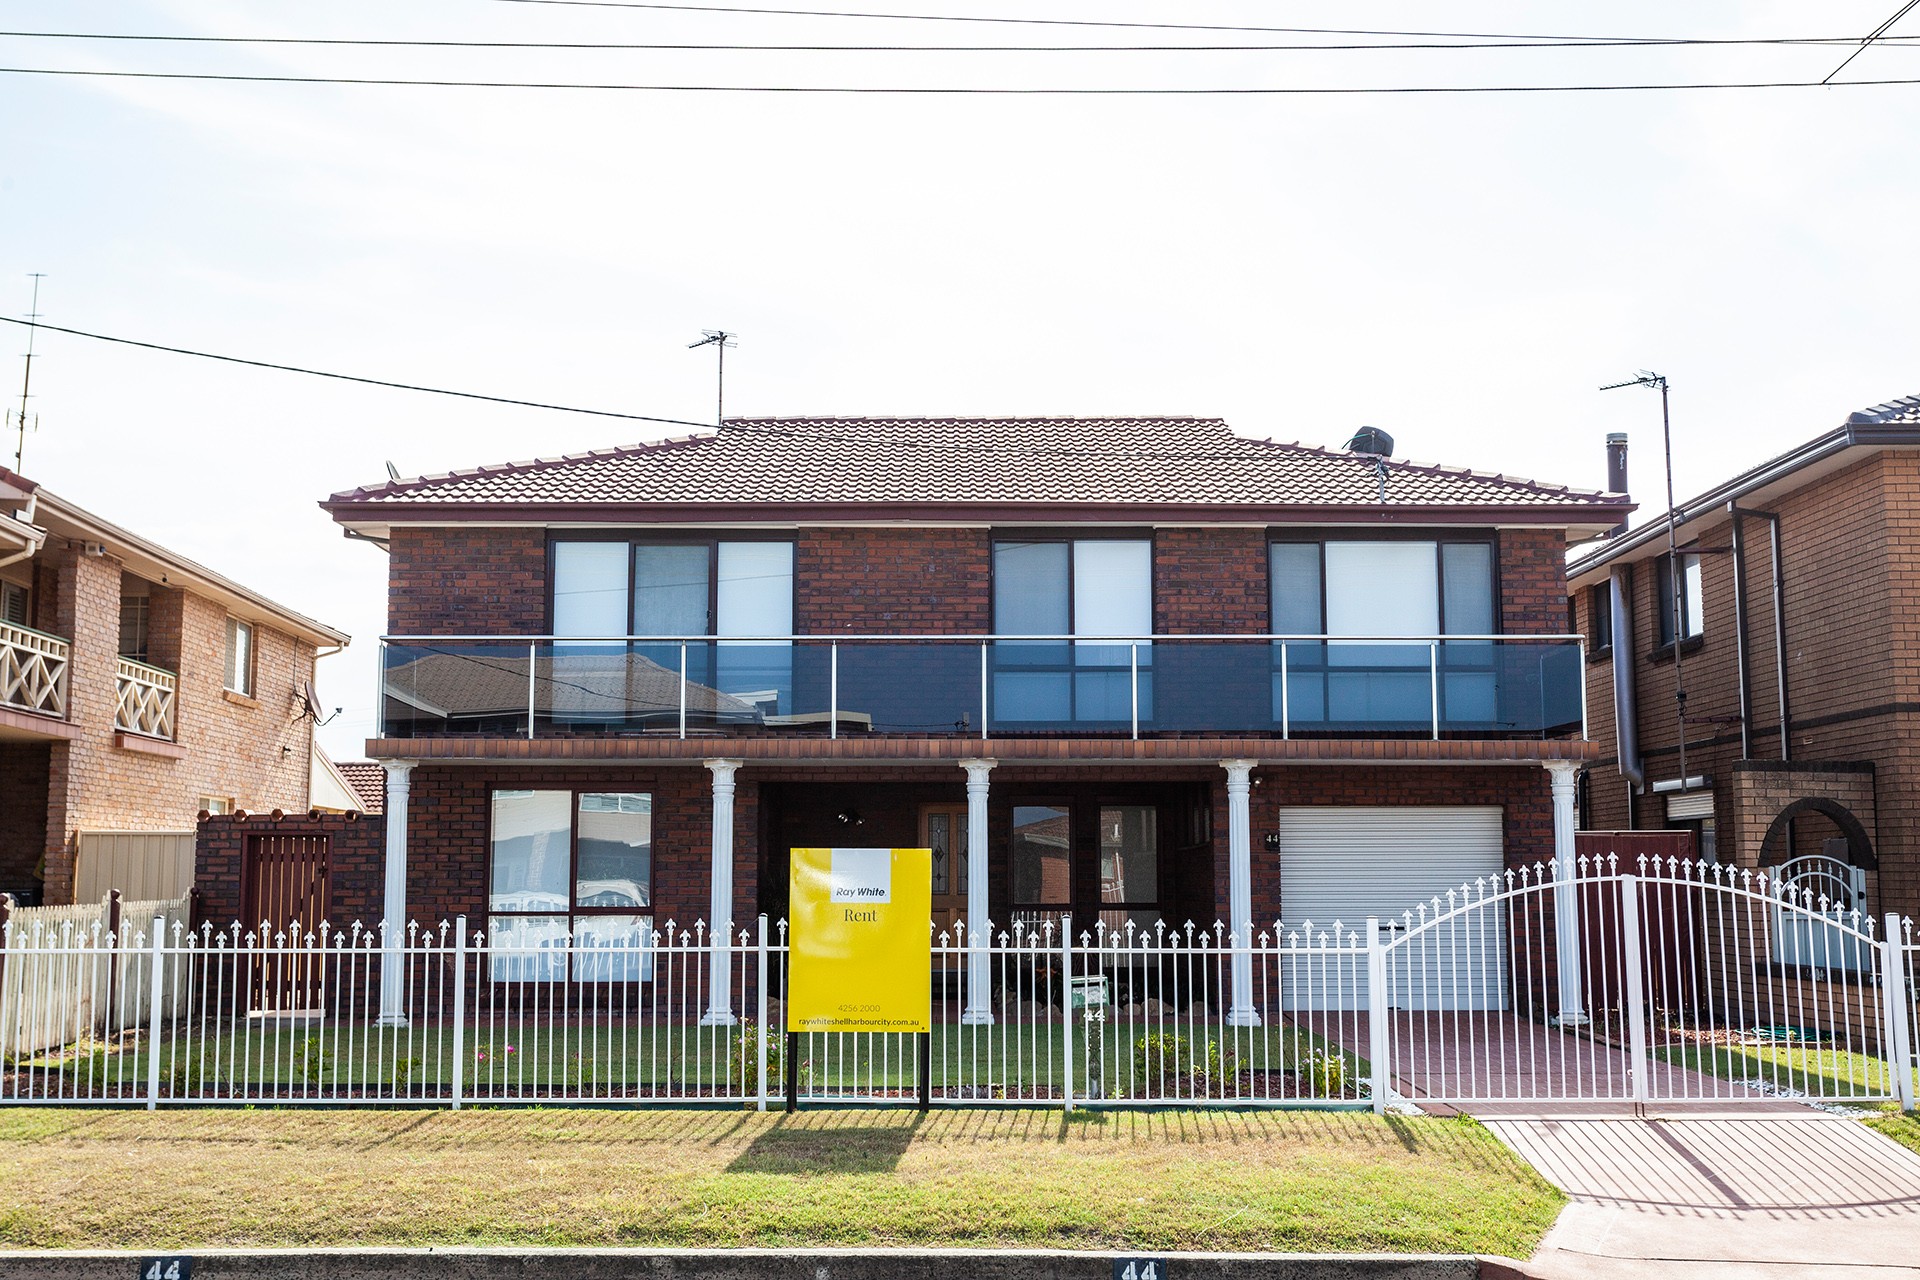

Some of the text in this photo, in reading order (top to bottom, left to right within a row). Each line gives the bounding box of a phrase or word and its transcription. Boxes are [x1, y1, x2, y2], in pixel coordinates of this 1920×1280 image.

[1266, 834, 1279, 843] 44
[836, 887, 856, 897] Ray
[844, 908, 879, 922] Rent
[837, 1004, 881, 1013] 4256 2000
[799, 1018, 919, 1027] raywhiteshellharbourcity.com.au
[145, 1260, 181, 1280] 44
[1121, 1261, 1158, 1280] 44
